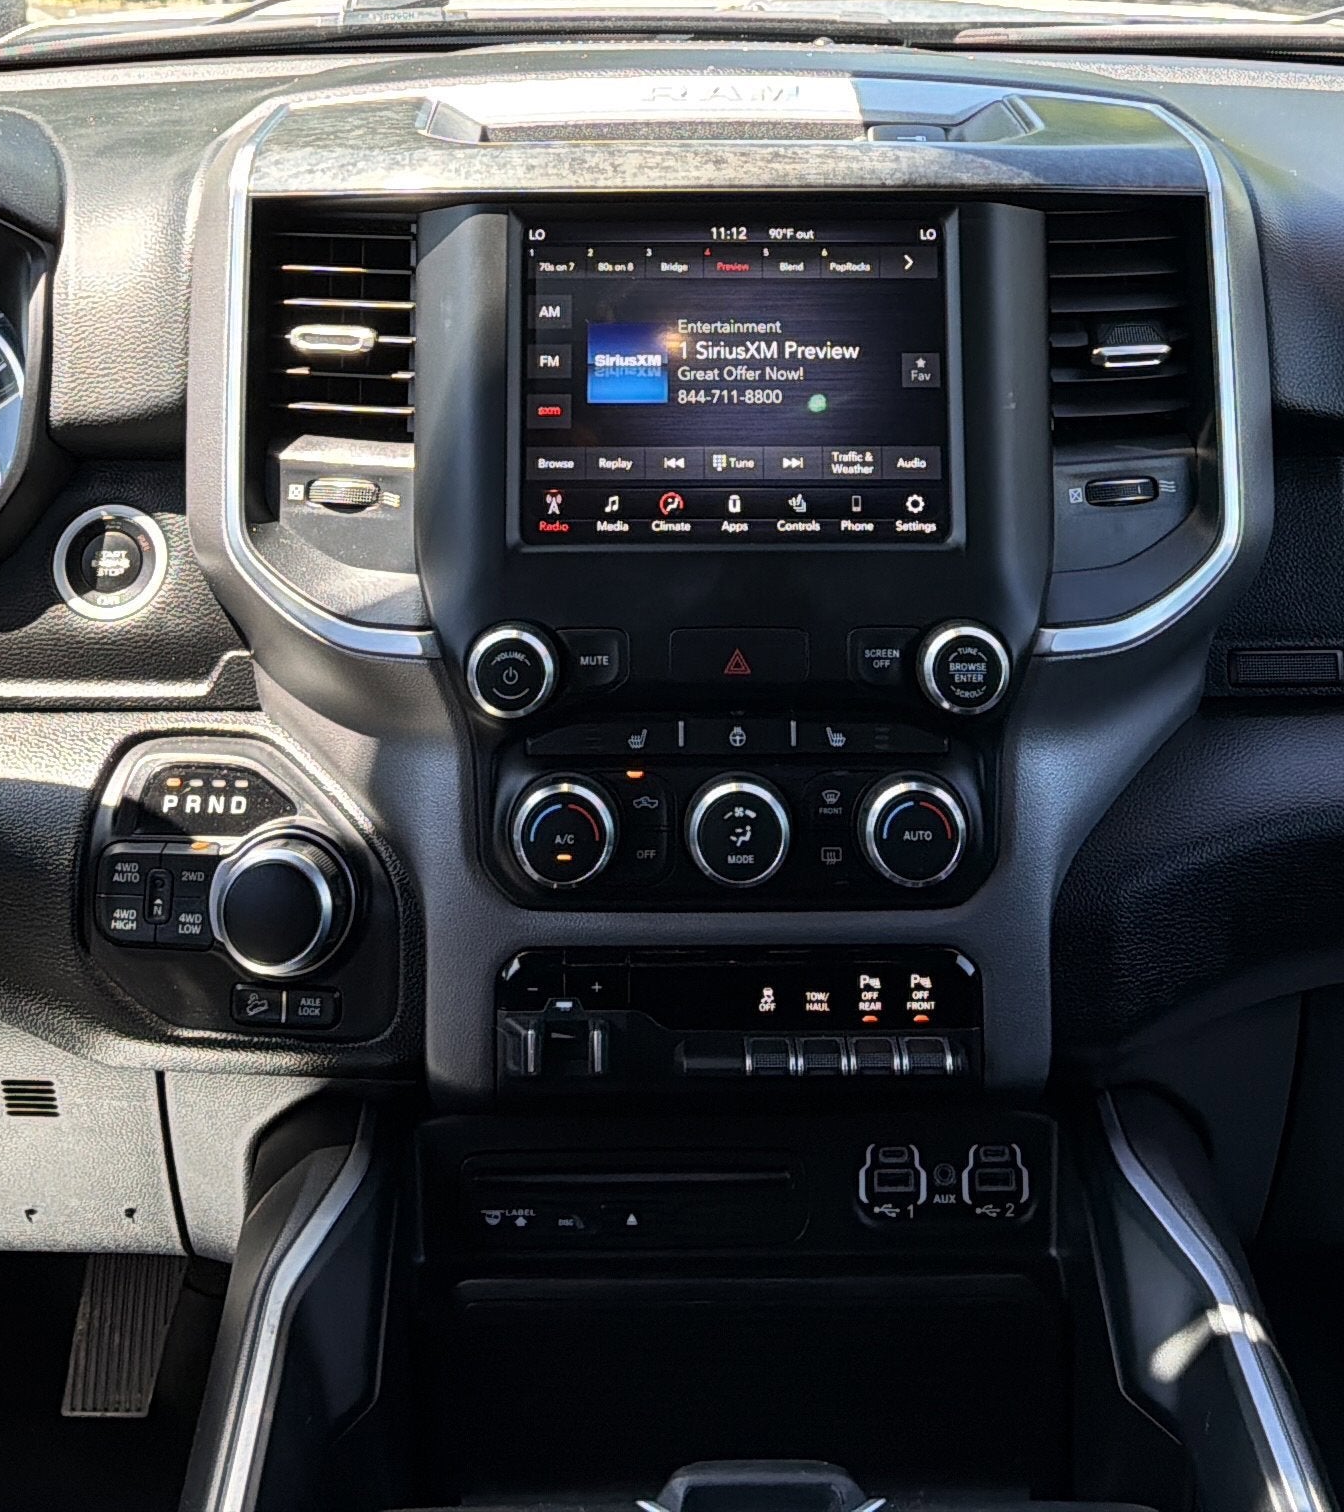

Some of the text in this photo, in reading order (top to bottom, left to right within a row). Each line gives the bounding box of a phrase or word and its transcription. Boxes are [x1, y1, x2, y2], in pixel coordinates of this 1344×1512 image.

[529, 229, 546, 240] LO
[710, 227, 748, 240] 11:12
[768, 228, 814, 240] 90°F out
[919, 229, 937, 240] LO
[530, 248, 535, 256] 1
[587, 248, 594, 256] 2
[646, 248, 652, 256] 3
[704, 248, 711, 256] 4
[763, 248, 769, 256] 5
[821, 248, 828, 256] 6
[569, 262, 575, 271] 7
[660, 262, 689, 273] Bridge
[716, 262, 750, 271] Preview
[779, 262, 805, 271] Blend
[829, 262, 871, 272] PopRocks
[539, 306, 561, 318] AM
[677, 319, 782, 334] Entertainment
[679, 341, 860, 359] 1 SiriusXM Preview
[539, 355, 560, 367] FM
[594, 354, 662, 367] SiriusXM
[677, 365, 804, 381] Great Offer Now!
[910, 369, 931, 382] Fav
[677, 389, 783, 404] 844-711-8800
[831, 451, 873, 462] Traffic &
[537, 458, 574, 469] Browse
[598, 457, 633, 471] Replay
[729, 458, 755, 468] Tune
[897, 457, 927, 468] Audio
[831, 463, 874, 474] Weather
[539, 520, 568, 531] Radio
[596, 520, 629, 532] Media
[651, 520, 691, 532] Climate
[721, 521, 749, 534] Apps
[776, 520, 820, 532] Controls
[840, 520, 874, 531] Phone
[895, 520, 937, 533] Settings
[495, 650, 527, 662] VOLUME
[864, 648, 900, 658] SCREEN
[957, 646, 979, 656] TUNE
[579, 655, 609, 666] MUTE
[872, 659, 891, 669] OFF
[949, 662, 987, 672] BROWSE
[954, 673, 984, 683] ENTER
[955, 688, 984, 699] SCROLL
[818, 807, 843, 815] FRONT
[555, 834, 575, 845] A/C
[903, 830, 933, 841] AUTO
[636, 850, 656, 859] OFF
[727, 854, 755, 864] MODE
[114, 862, 139, 872] 4WD
[112, 872, 140, 883] AUTO
[181, 871, 205, 882] 2WD
[113, 908, 137, 920] 4WD
[153, 905, 162, 915] N
[178, 913, 202, 924] 4WD
[111, 919, 137, 930] HIGH
[178, 924, 202, 935] LOW
[806, 991, 830, 1002] TOW/
[861, 991, 879, 1001] OFF
[912, 990, 929, 1000] OFF
[300, 997, 322, 1007] AXLE
[758, 1002, 776, 1012] OFF
[806, 1002, 830, 1012] HAUL
[858, 1001, 882, 1011] REAR
[907, 1001, 936, 1011] FRONT
[298, 1006, 321, 1016] LOCK
[933, 1194, 957, 1204] AUX
[506, 1208, 536, 1217] LABEL
[906, 1204, 914, 1219] 1
[1005, 1203, 1015, 1217] 2
